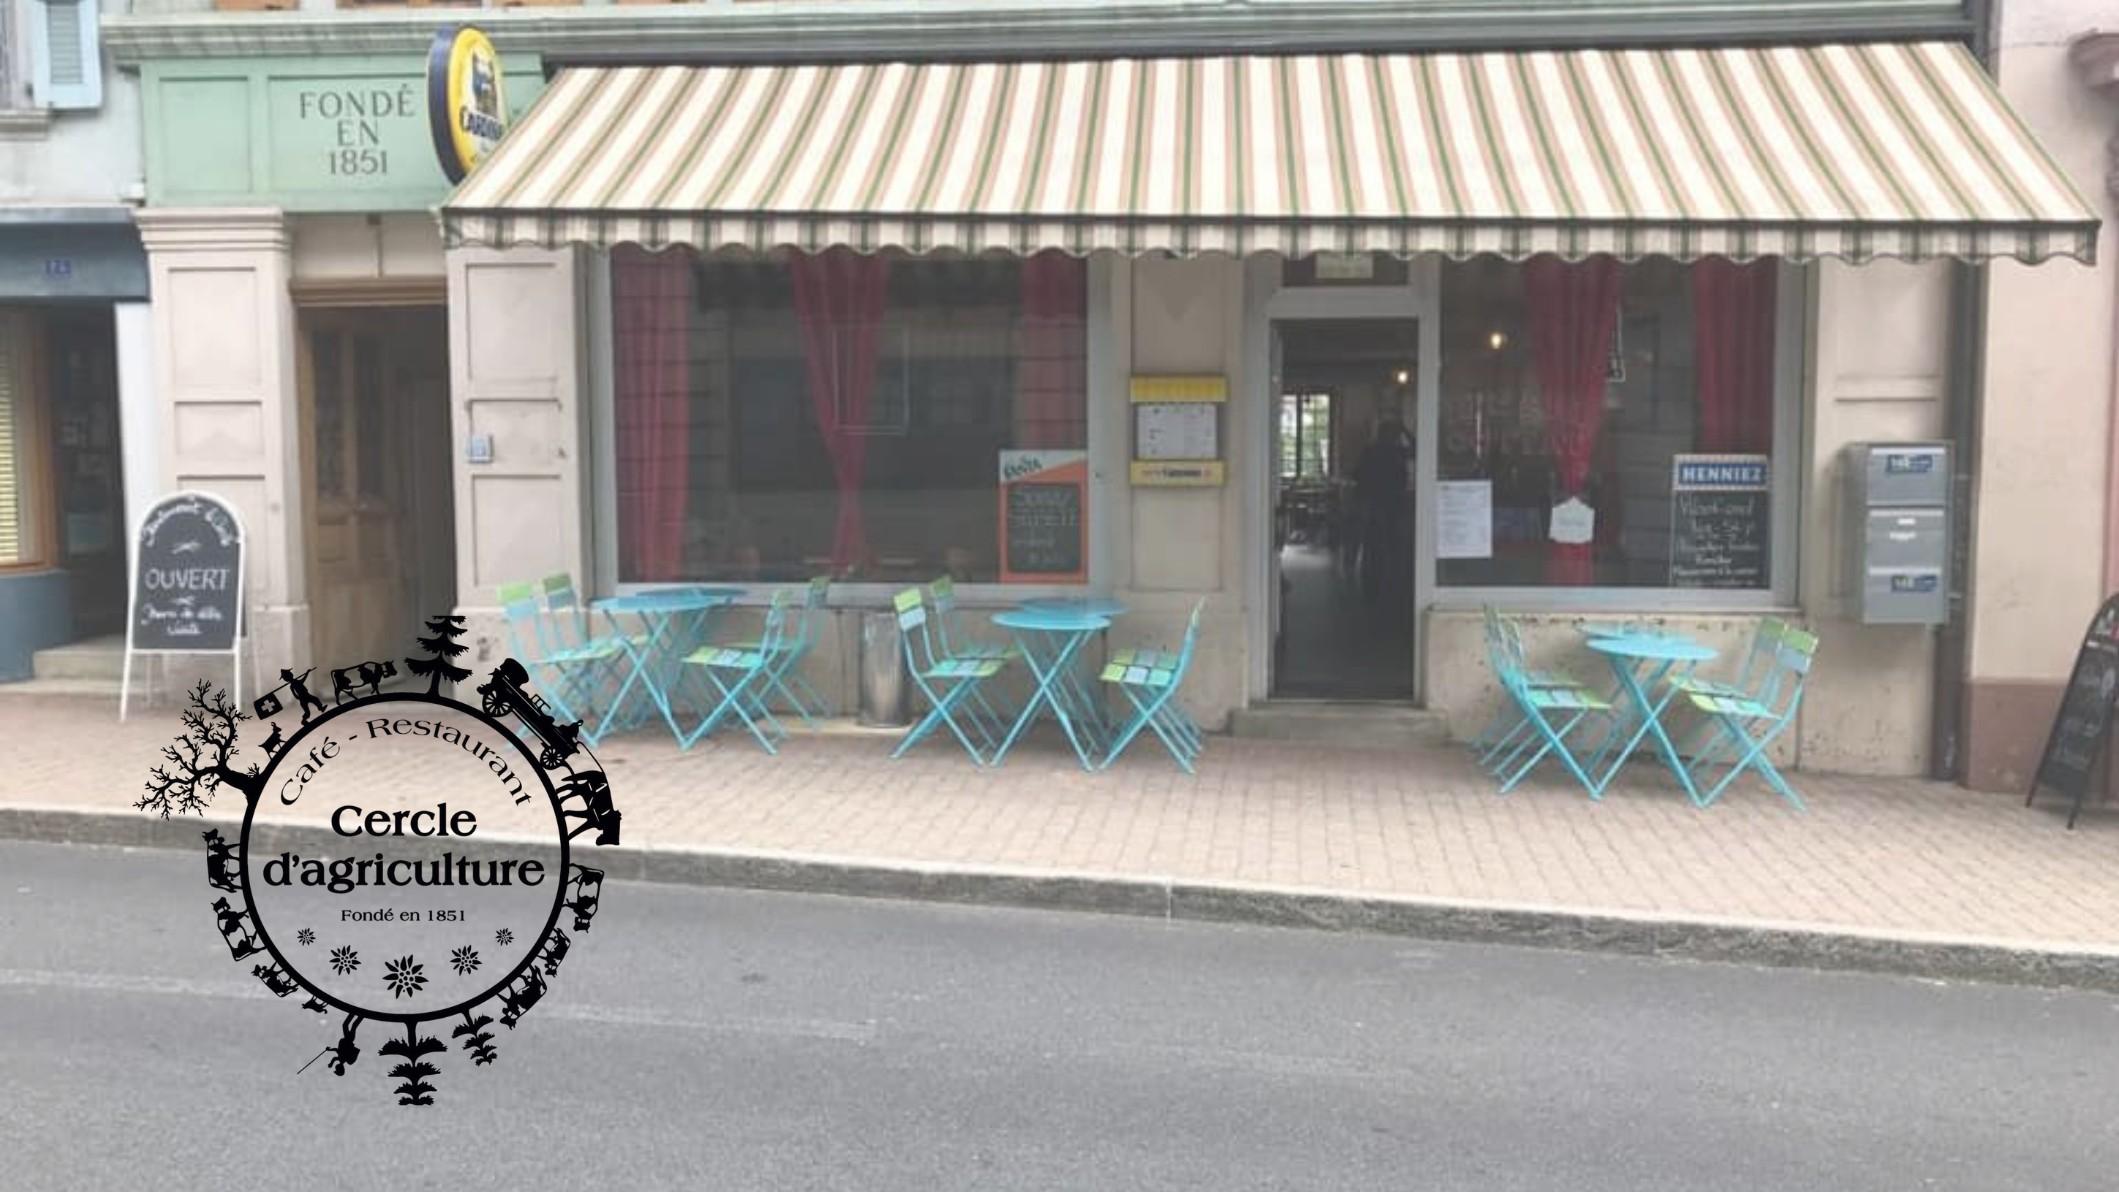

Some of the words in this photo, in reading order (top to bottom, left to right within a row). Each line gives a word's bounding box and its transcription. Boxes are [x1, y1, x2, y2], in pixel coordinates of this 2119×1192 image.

[299, 83, 416, 119] FONDÉ
[336, 119, 379, 146] EN
[329, 149, 388, 175] 1851
[1682, 466, 1762, 482] HENNIEZ
[144, 568, 230, 590] OUVERT
